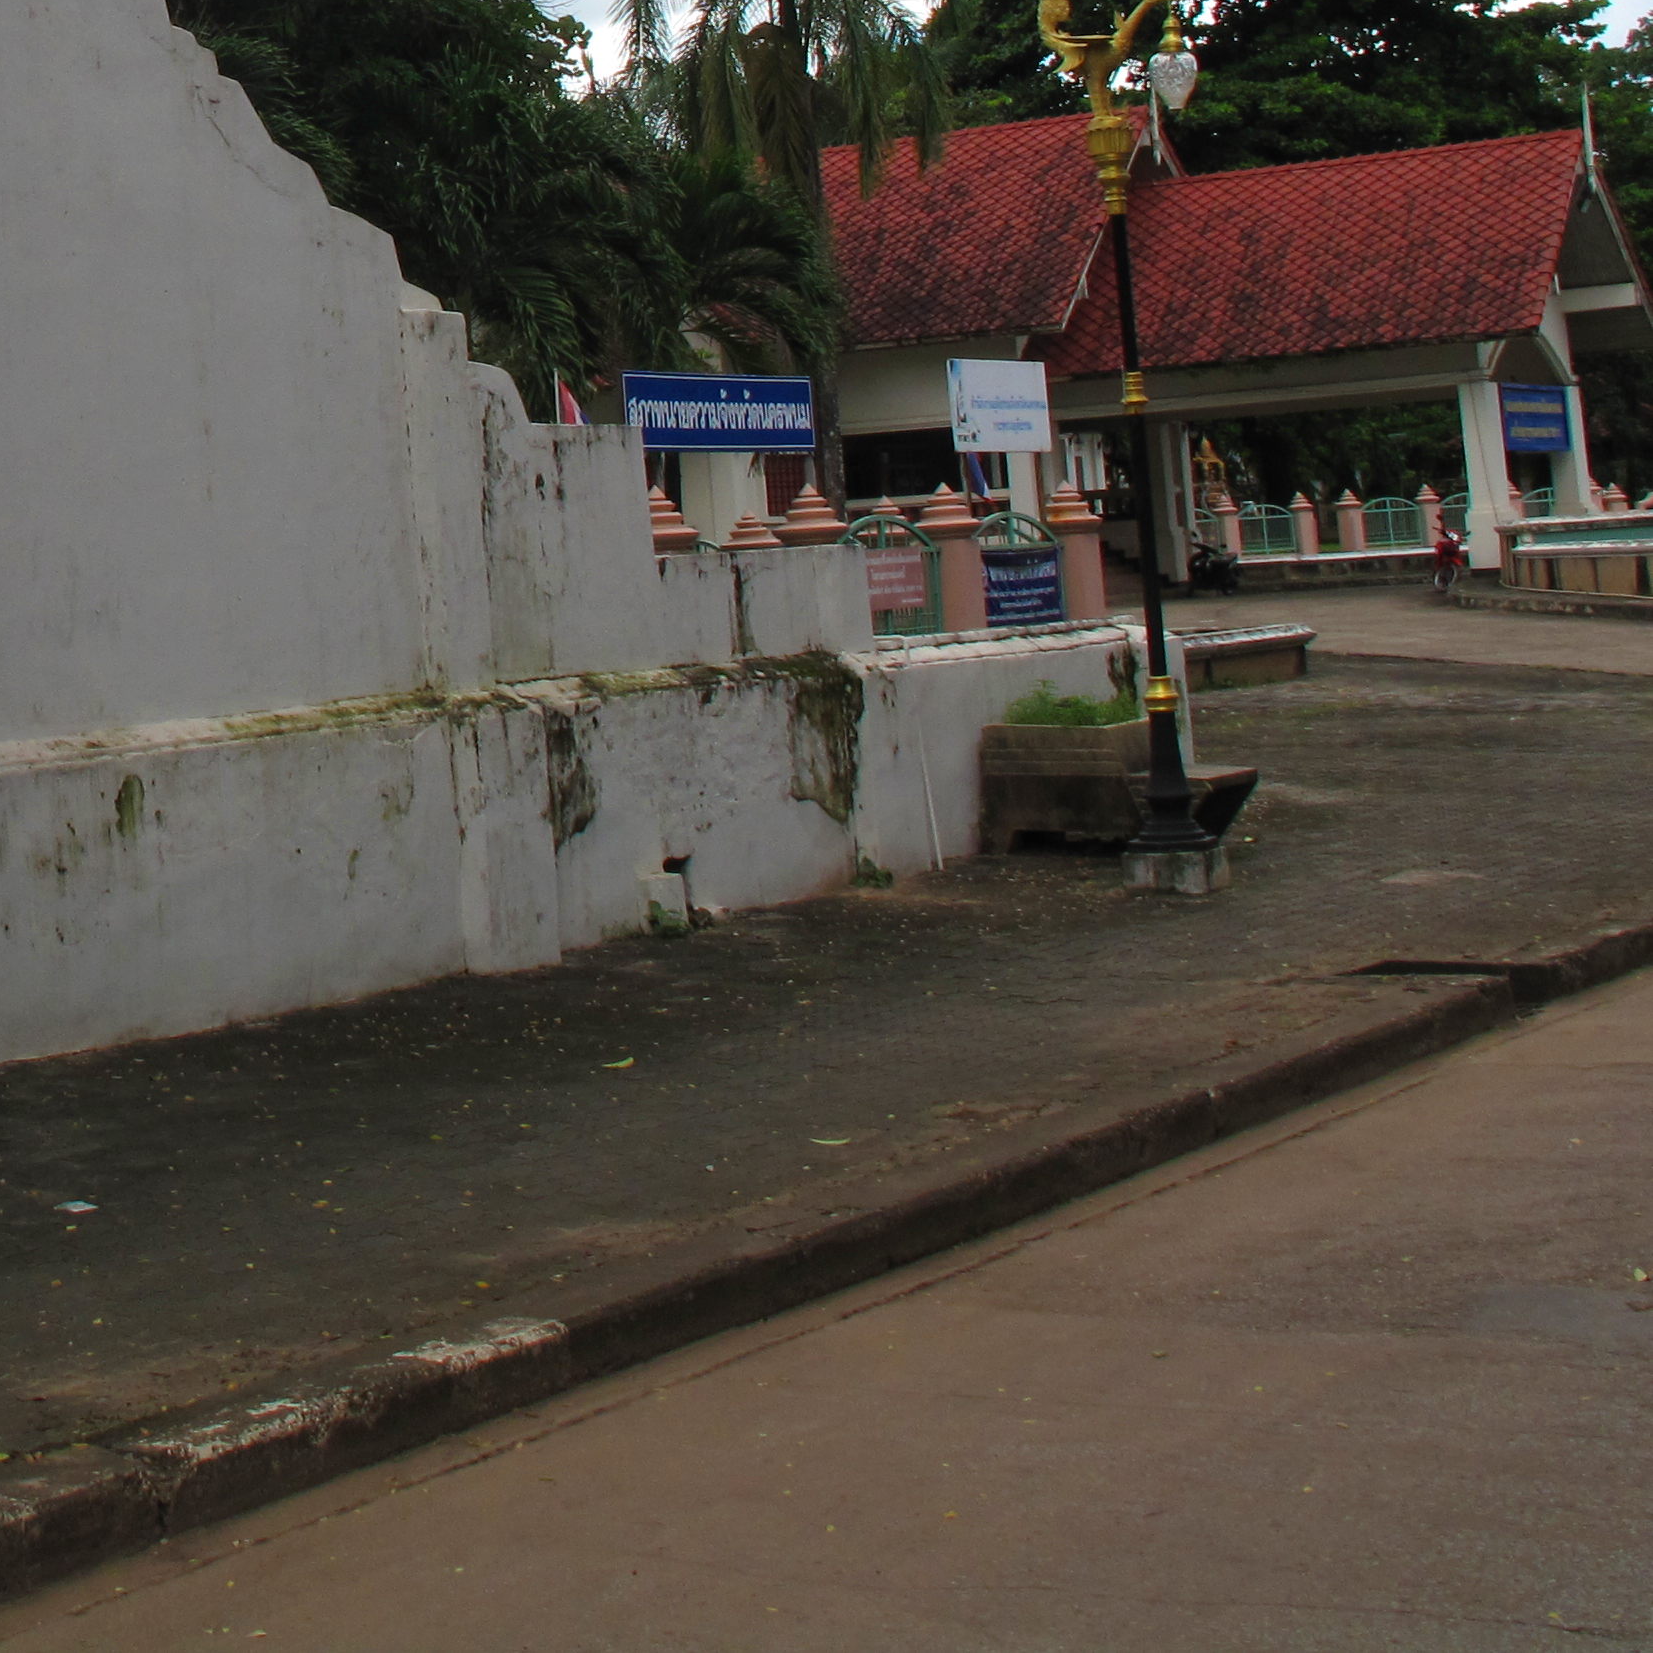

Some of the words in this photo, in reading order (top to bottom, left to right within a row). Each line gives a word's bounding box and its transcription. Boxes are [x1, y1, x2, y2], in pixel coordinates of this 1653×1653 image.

[628, 388, 812, 430] สภาทนายความจังหวัดนครพนม
